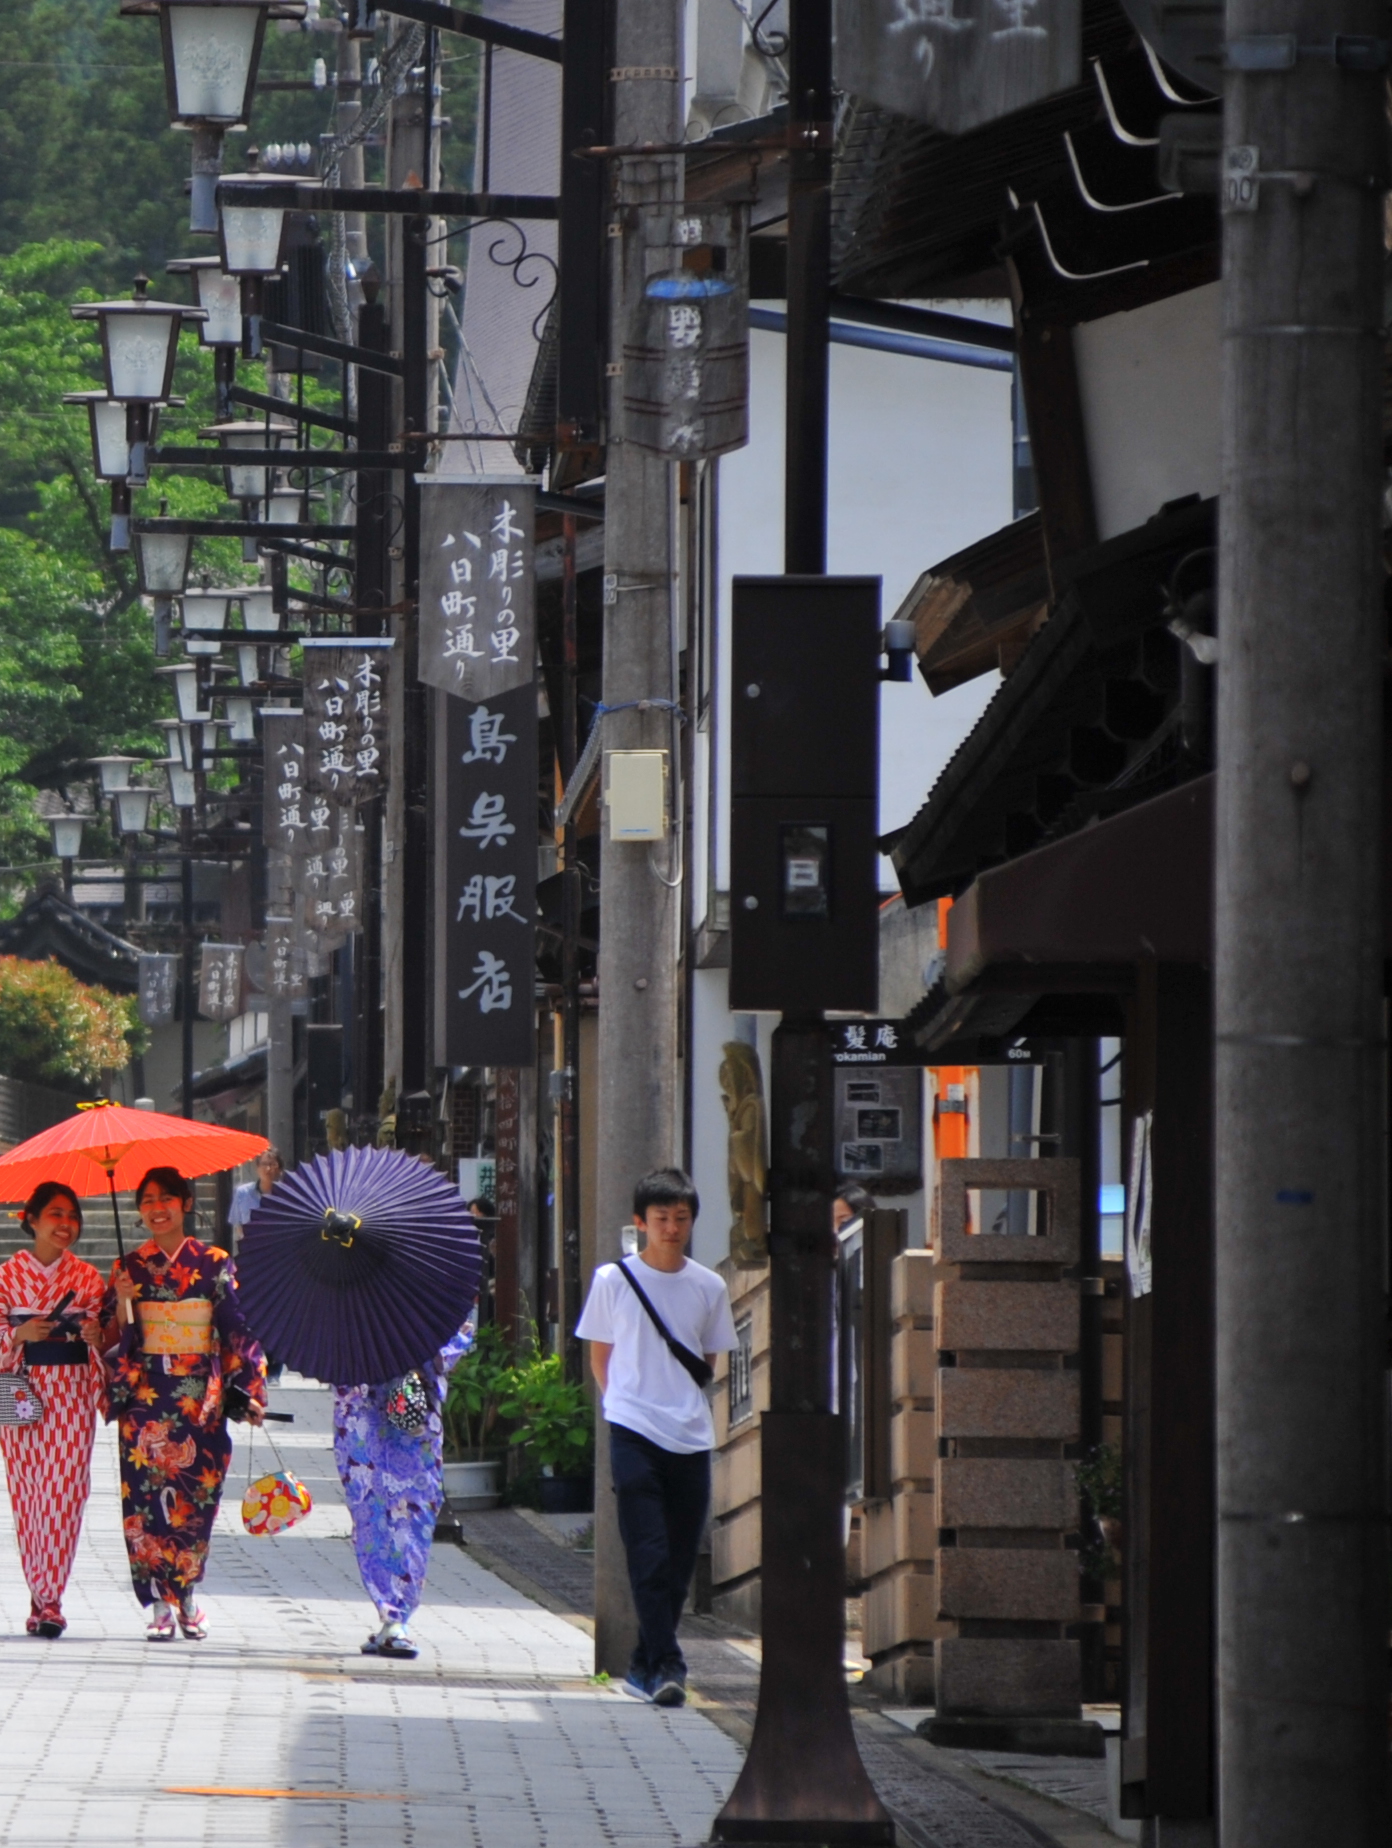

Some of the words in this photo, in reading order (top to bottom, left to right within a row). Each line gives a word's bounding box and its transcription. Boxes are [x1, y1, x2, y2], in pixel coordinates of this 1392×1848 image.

[441, 531, 486, 680] 八日町通り
[489, 500, 525, 663] 木彫りの里
[317, 676, 357, 791] 八日町通り
[353, 653, 382, 777] 木彫りの里
[277, 743, 309, 842] 八日町通り
[458, 705, 528, 1013] 島呉服店
[833, 1025, 898, 1049] 髪庵
